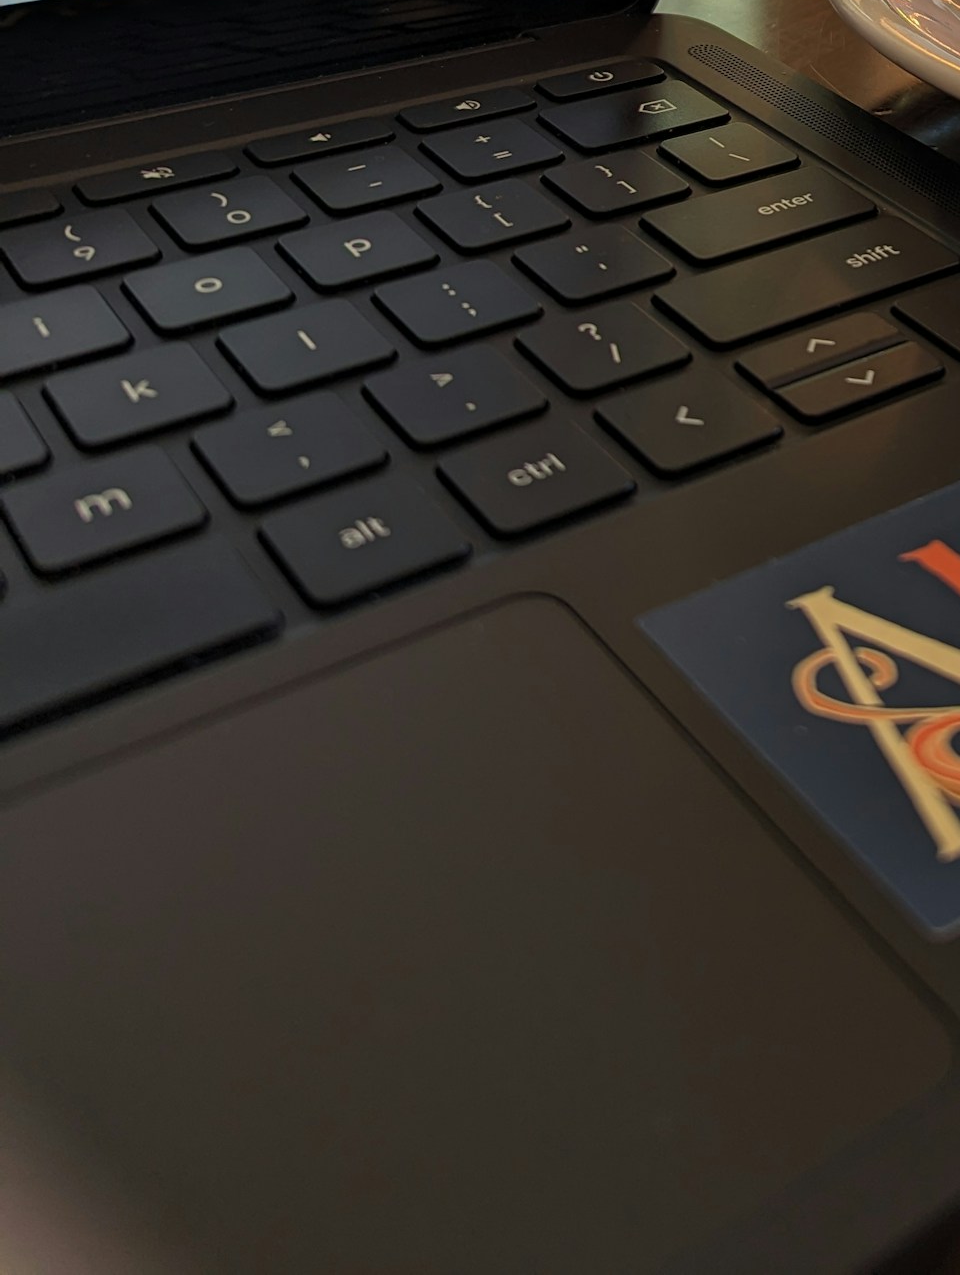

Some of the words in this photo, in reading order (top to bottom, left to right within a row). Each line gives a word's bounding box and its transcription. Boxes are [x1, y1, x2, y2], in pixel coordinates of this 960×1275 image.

[758, 192, 815, 216] enter
[73, 246, 95, 262] 9
[343, 238, 372, 258] p
[846, 244, 901, 269] shift
[120, 379, 158, 403] k
[507, 452, 567, 487] ctrl
[74, 487, 133, 523] m
[338, 516, 392, 549] alt
